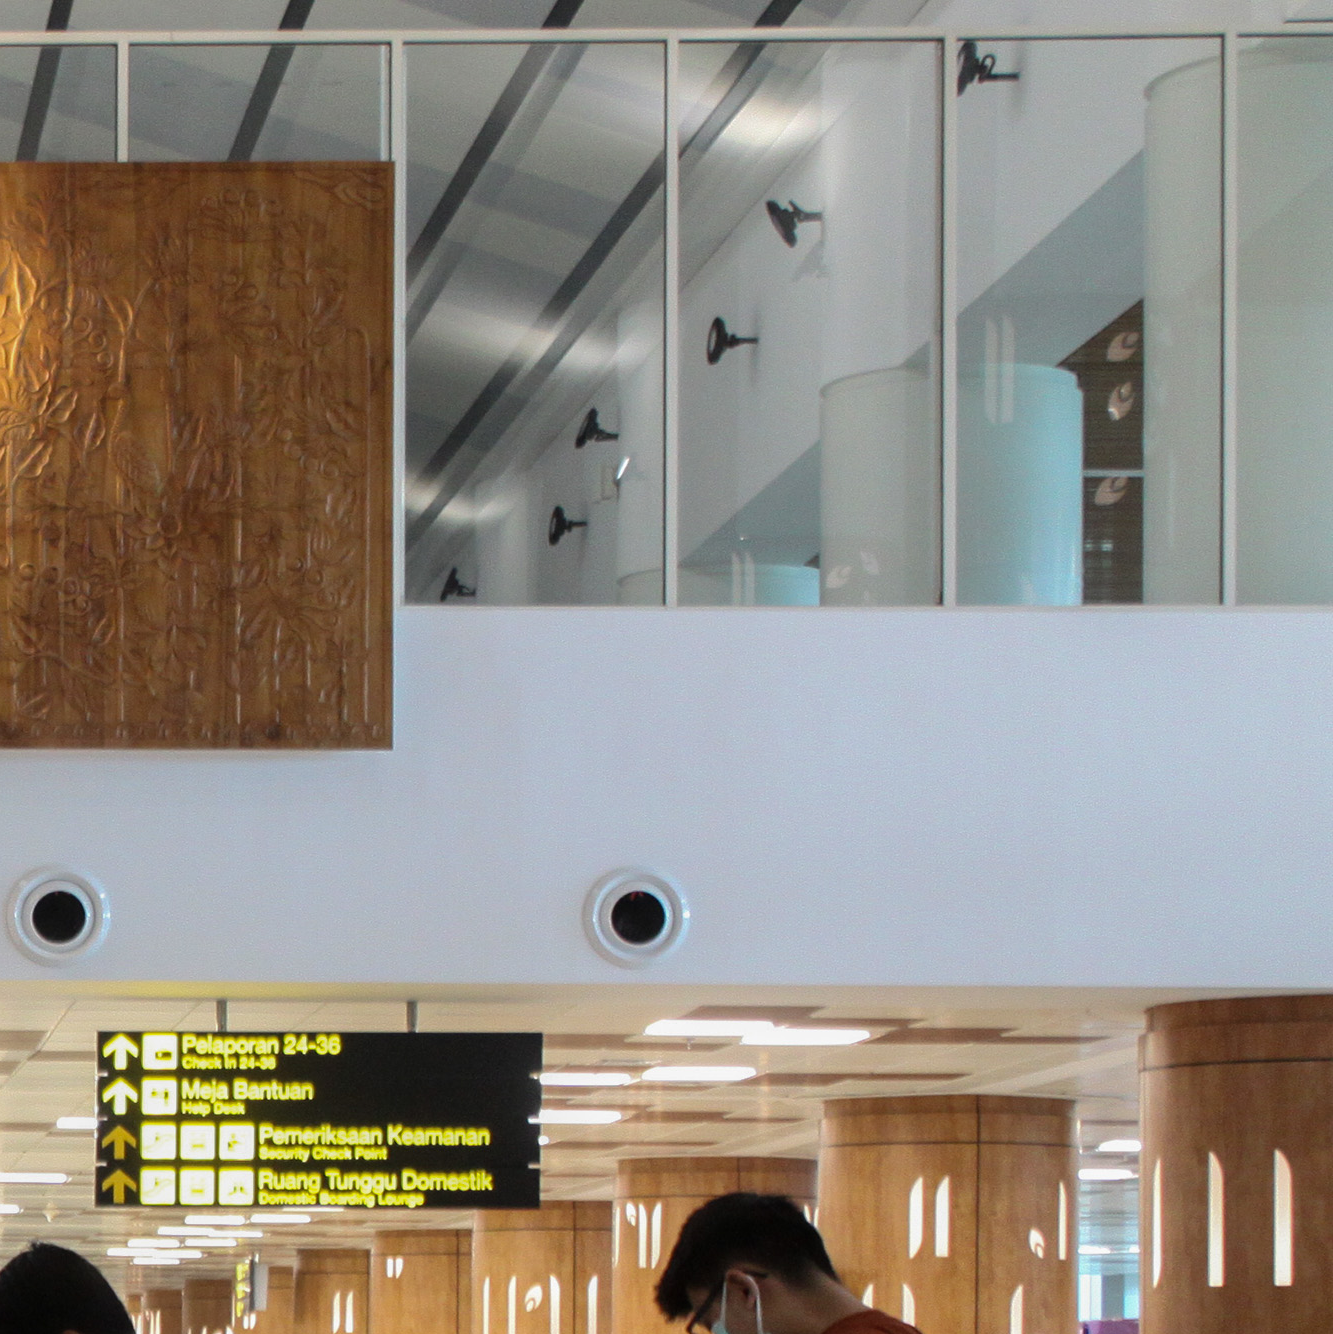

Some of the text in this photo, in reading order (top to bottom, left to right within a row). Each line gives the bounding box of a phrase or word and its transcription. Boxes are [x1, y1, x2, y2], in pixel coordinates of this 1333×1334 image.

[181, 1033, 342, 1057] Pelaporan 24-36
[181, 1055, 222, 1070] Check
[181, 1078, 315, 1103] Meja Bantuan
[181, 1102, 246, 1117] Help Desk
[258, 1122, 491, 1147] Pemeriksaan Keamanan
[258, 1146, 388, 1162] Security Check Point
[258, 1166, 493, 1195] Ruang Tunggu Domestik
[258, 1191, 425, 1208] Domestic Boarding Lounge
